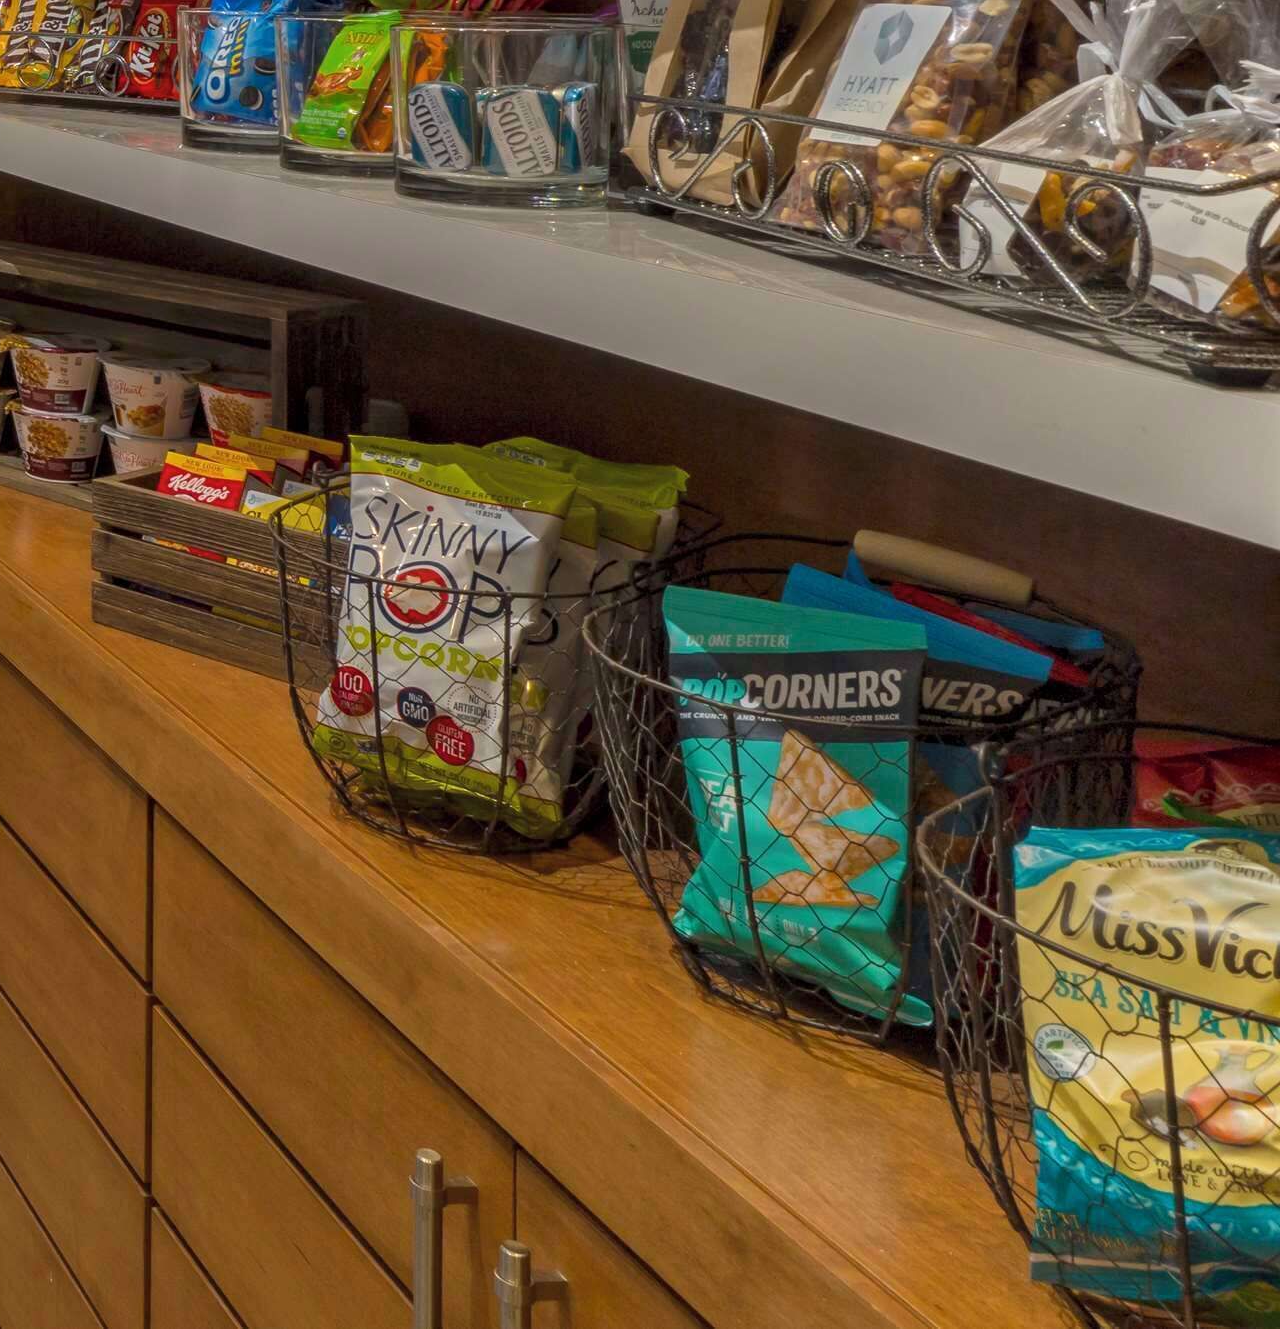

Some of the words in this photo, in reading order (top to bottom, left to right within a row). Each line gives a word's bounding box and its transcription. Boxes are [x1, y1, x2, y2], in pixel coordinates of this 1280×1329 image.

[206, 16, 242, 101] OREO
[842, 74, 899, 95] HYATT
[410, 92, 454, 169] ALTOIDS
[446, 128, 464, 161] SMALLS
[492, 100, 544, 177] ALTOIDS
[533, 134, 553, 168] SMALLS
[168, 472, 230, 503] Kellogg's
[386, 468, 414, 480] PURE
[418, 477, 460, 494] POPPED
[465, 488, 526, 504] PERFECTIO
[347, 543, 516, 645] POP
[686, 634, 705, 649] DO
[708, 634, 732, 649] ONE
[736, 633, 790, 649] BETTER!
[339, 671, 363, 693] 100
[679, 669, 902, 711] POPCORNERS
[402, 701, 429, 722] GMO
[453, 702, 491, 718] ARTIFICIAL
[693, 712, 728, 721] CRUNCH
[874, 713, 900, 722] SNACK
[433, 734, 467, 760] FREE
[1037, 881, 1185, 962] Miss
[1055, 970, 1108, 1009] SEA
[1117, 984, 1188, 1025] SAT
[1154, 1157, 1208, 1174] mde
